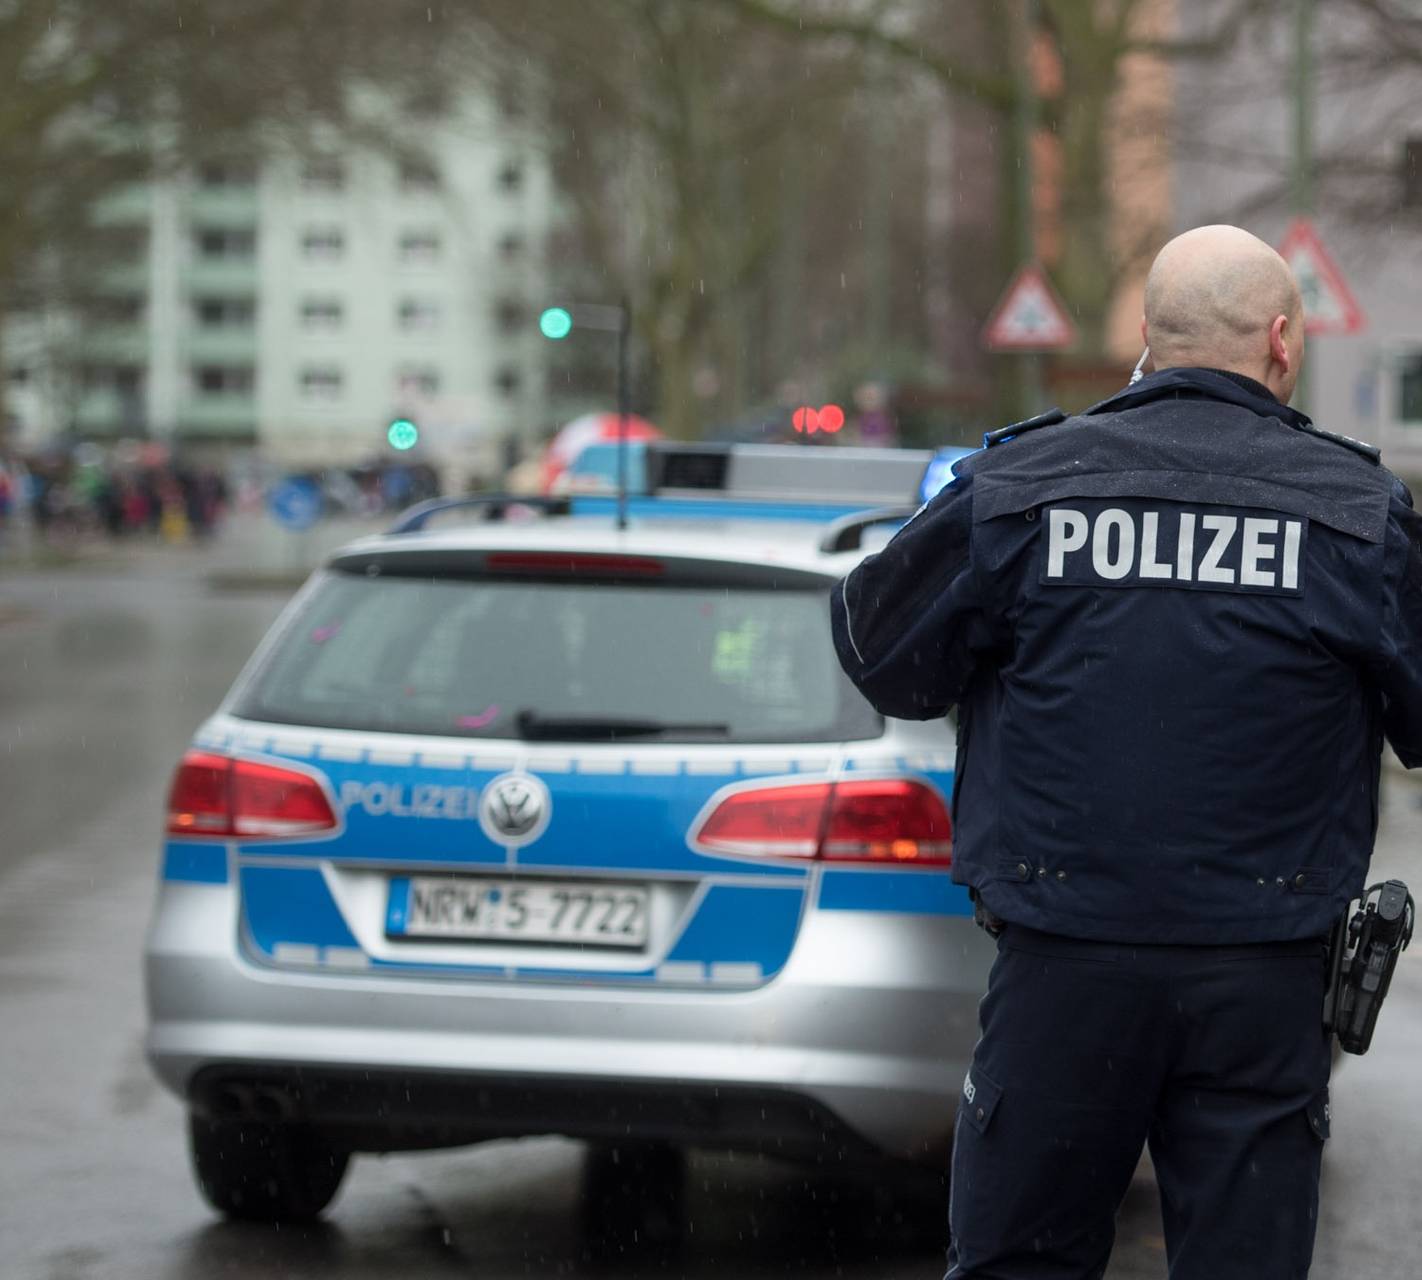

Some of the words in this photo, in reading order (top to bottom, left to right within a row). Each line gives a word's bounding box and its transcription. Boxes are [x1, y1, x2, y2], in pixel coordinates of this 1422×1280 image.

[1047, 508, 1302, 589] POLIZEI
[339, 781, 481, 820] POLIZEI
[411, 884, 482, 922] NRW
[505, 889, 641, 935] 5-7722
